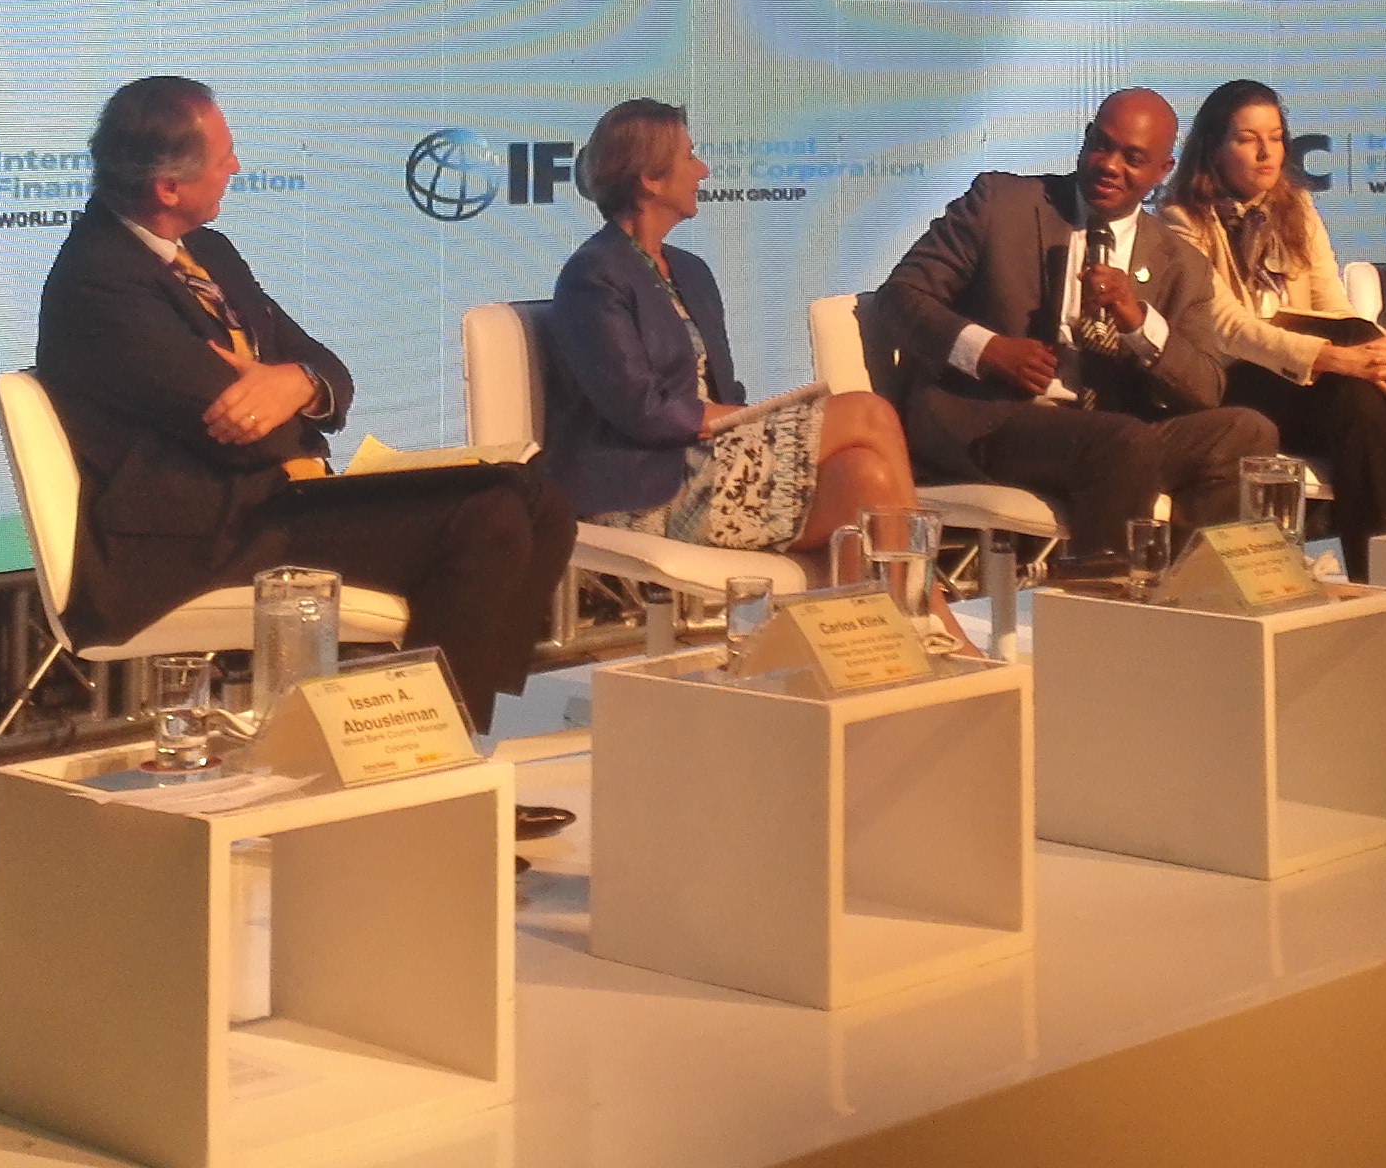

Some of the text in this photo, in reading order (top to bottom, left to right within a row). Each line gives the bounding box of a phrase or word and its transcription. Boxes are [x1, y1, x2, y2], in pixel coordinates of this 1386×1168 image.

[508, 142, 574, 205] IF
[697, 187, 808, 203] BANK GROUP
[348, 688, 414, 711] Issam A.
[343, 707, 440, 735] Abousleiman
